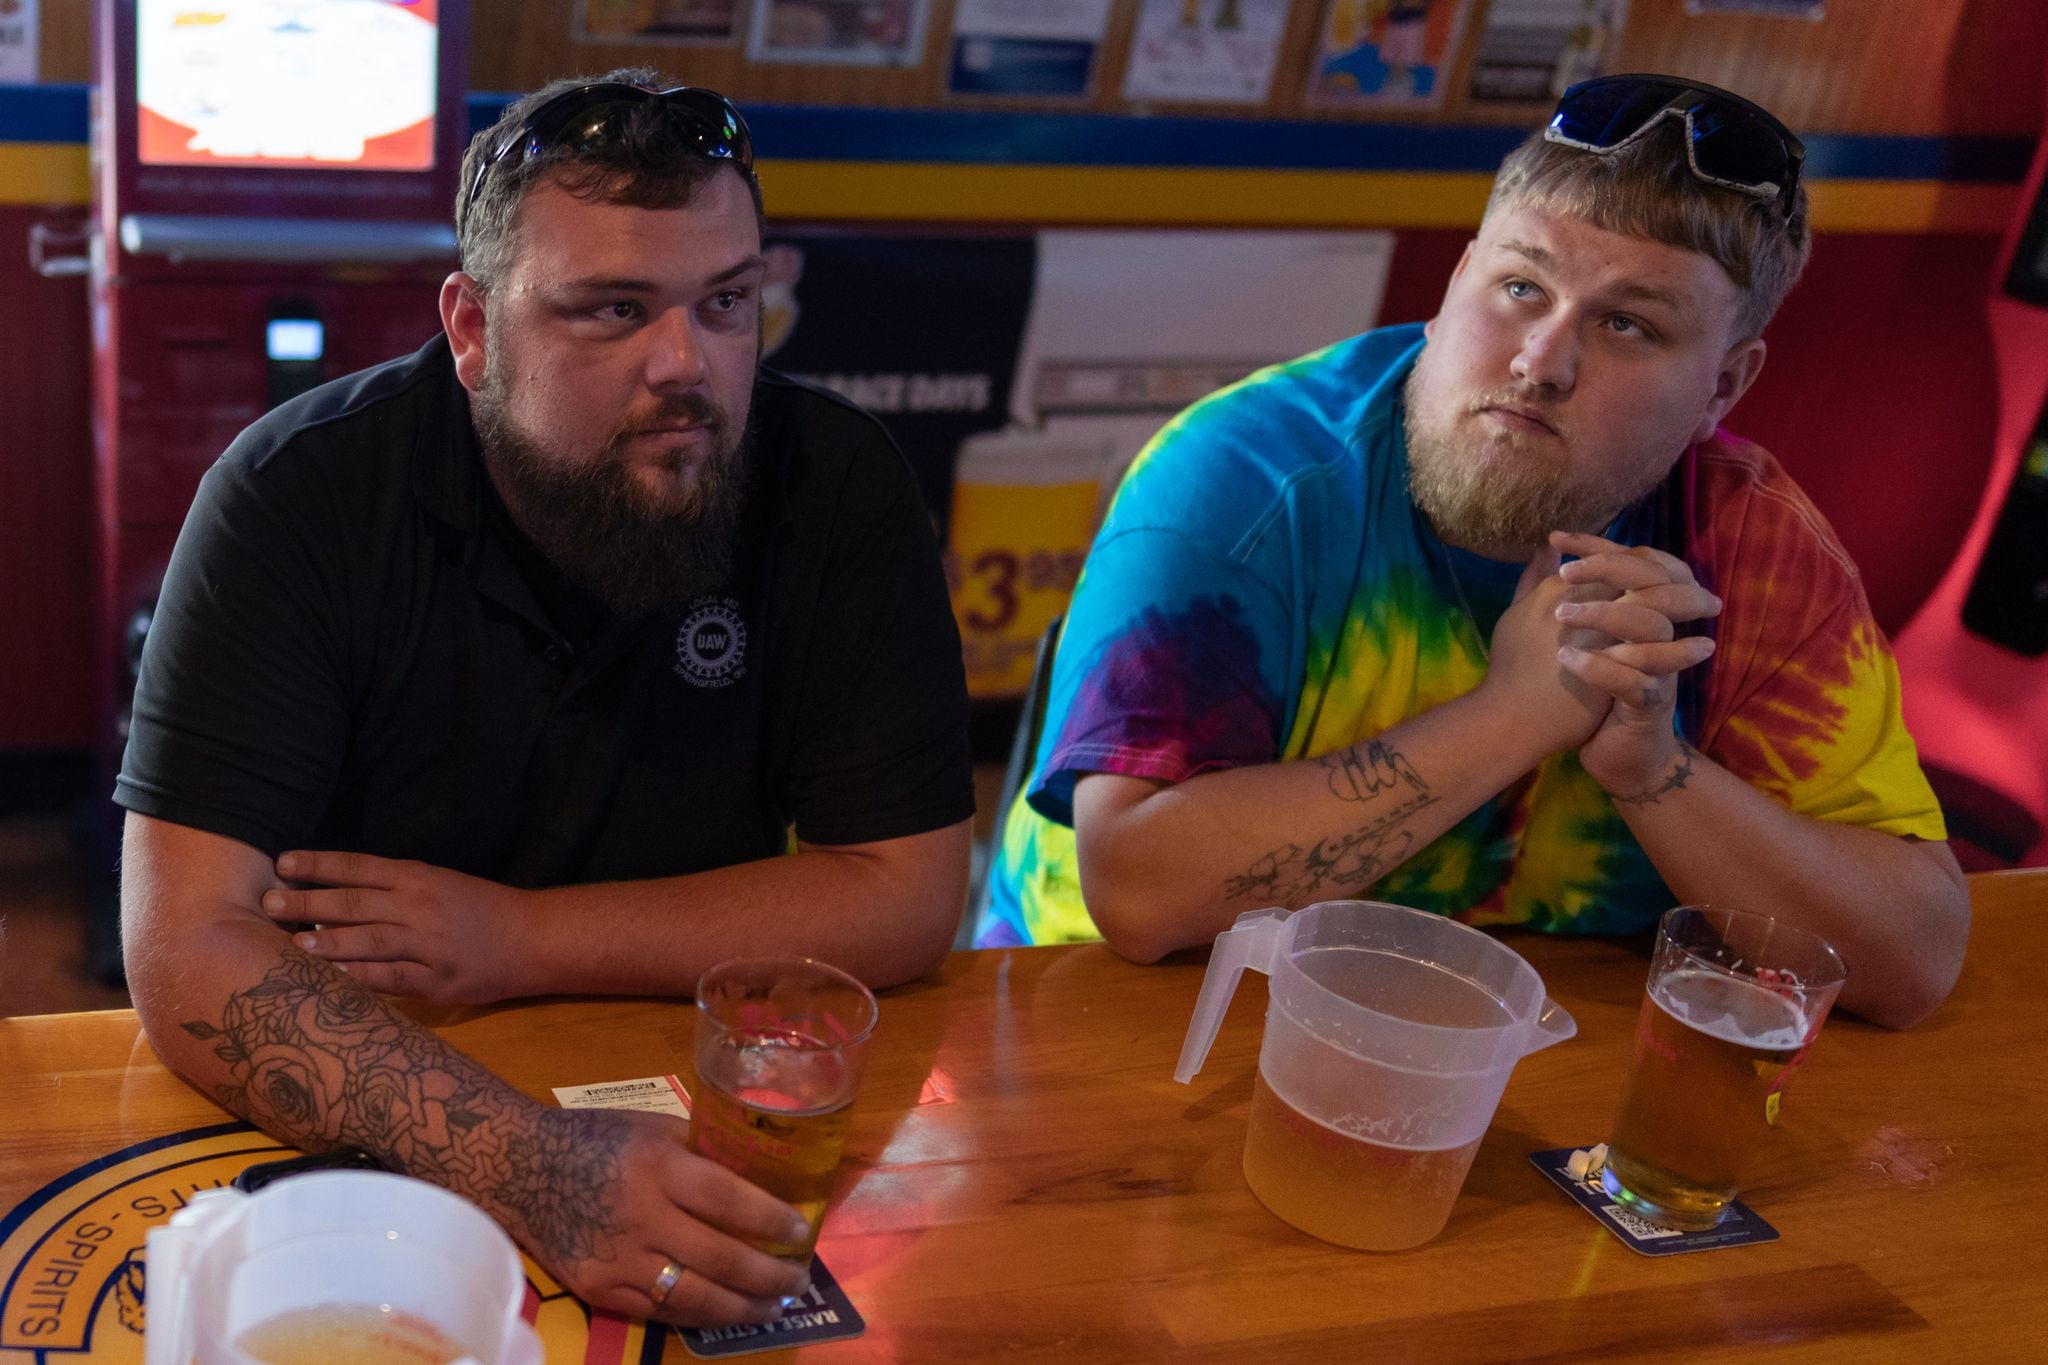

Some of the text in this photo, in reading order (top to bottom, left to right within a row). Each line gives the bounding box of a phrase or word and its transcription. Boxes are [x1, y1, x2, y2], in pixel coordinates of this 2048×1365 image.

[697, 633, 727, 650] UAW
[19, 1220, 114, 1338] SPIRITS
[779, 1309, 840, 1331] RAISE
